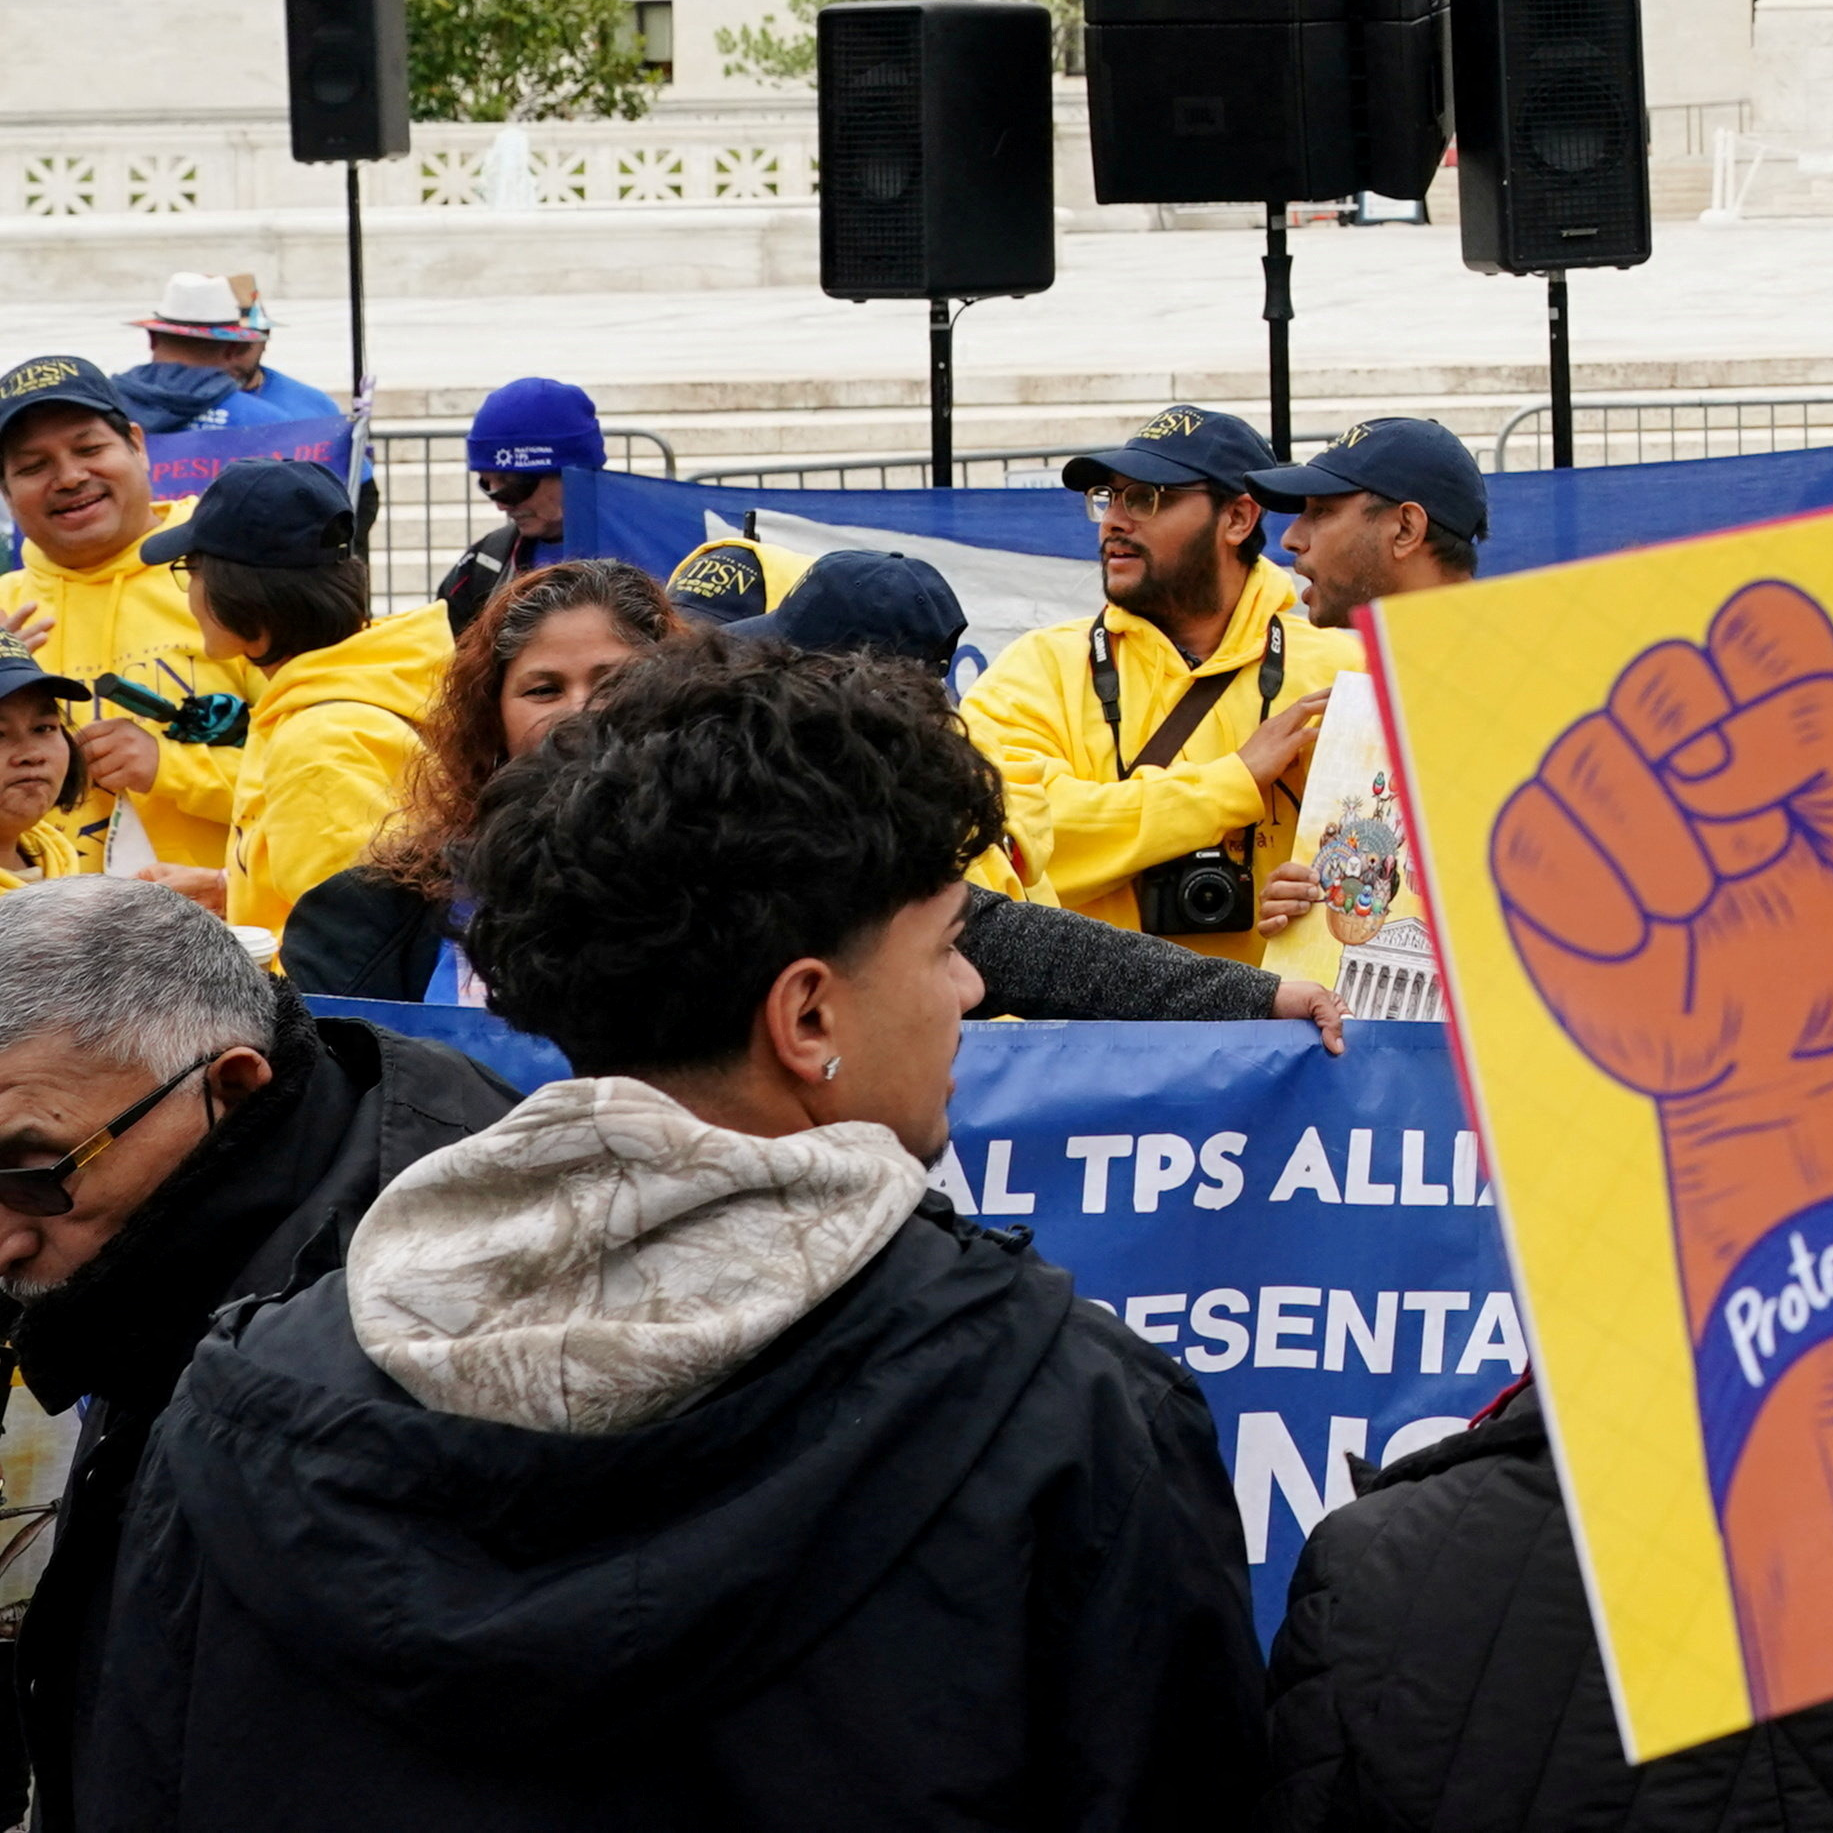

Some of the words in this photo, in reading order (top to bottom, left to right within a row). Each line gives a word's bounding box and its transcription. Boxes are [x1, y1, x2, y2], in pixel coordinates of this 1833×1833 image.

[1093, 627, 1107, 663] Canon
[1270, 627, 1282, 654] EOS
[930, 1139, 1035, 1216] AL
[1065, 1129, 1249, 1214] TPS
[1268, 1125, 1497, 1208] ALLI
[1093, 1285, 1531, 1375] ESENTA
